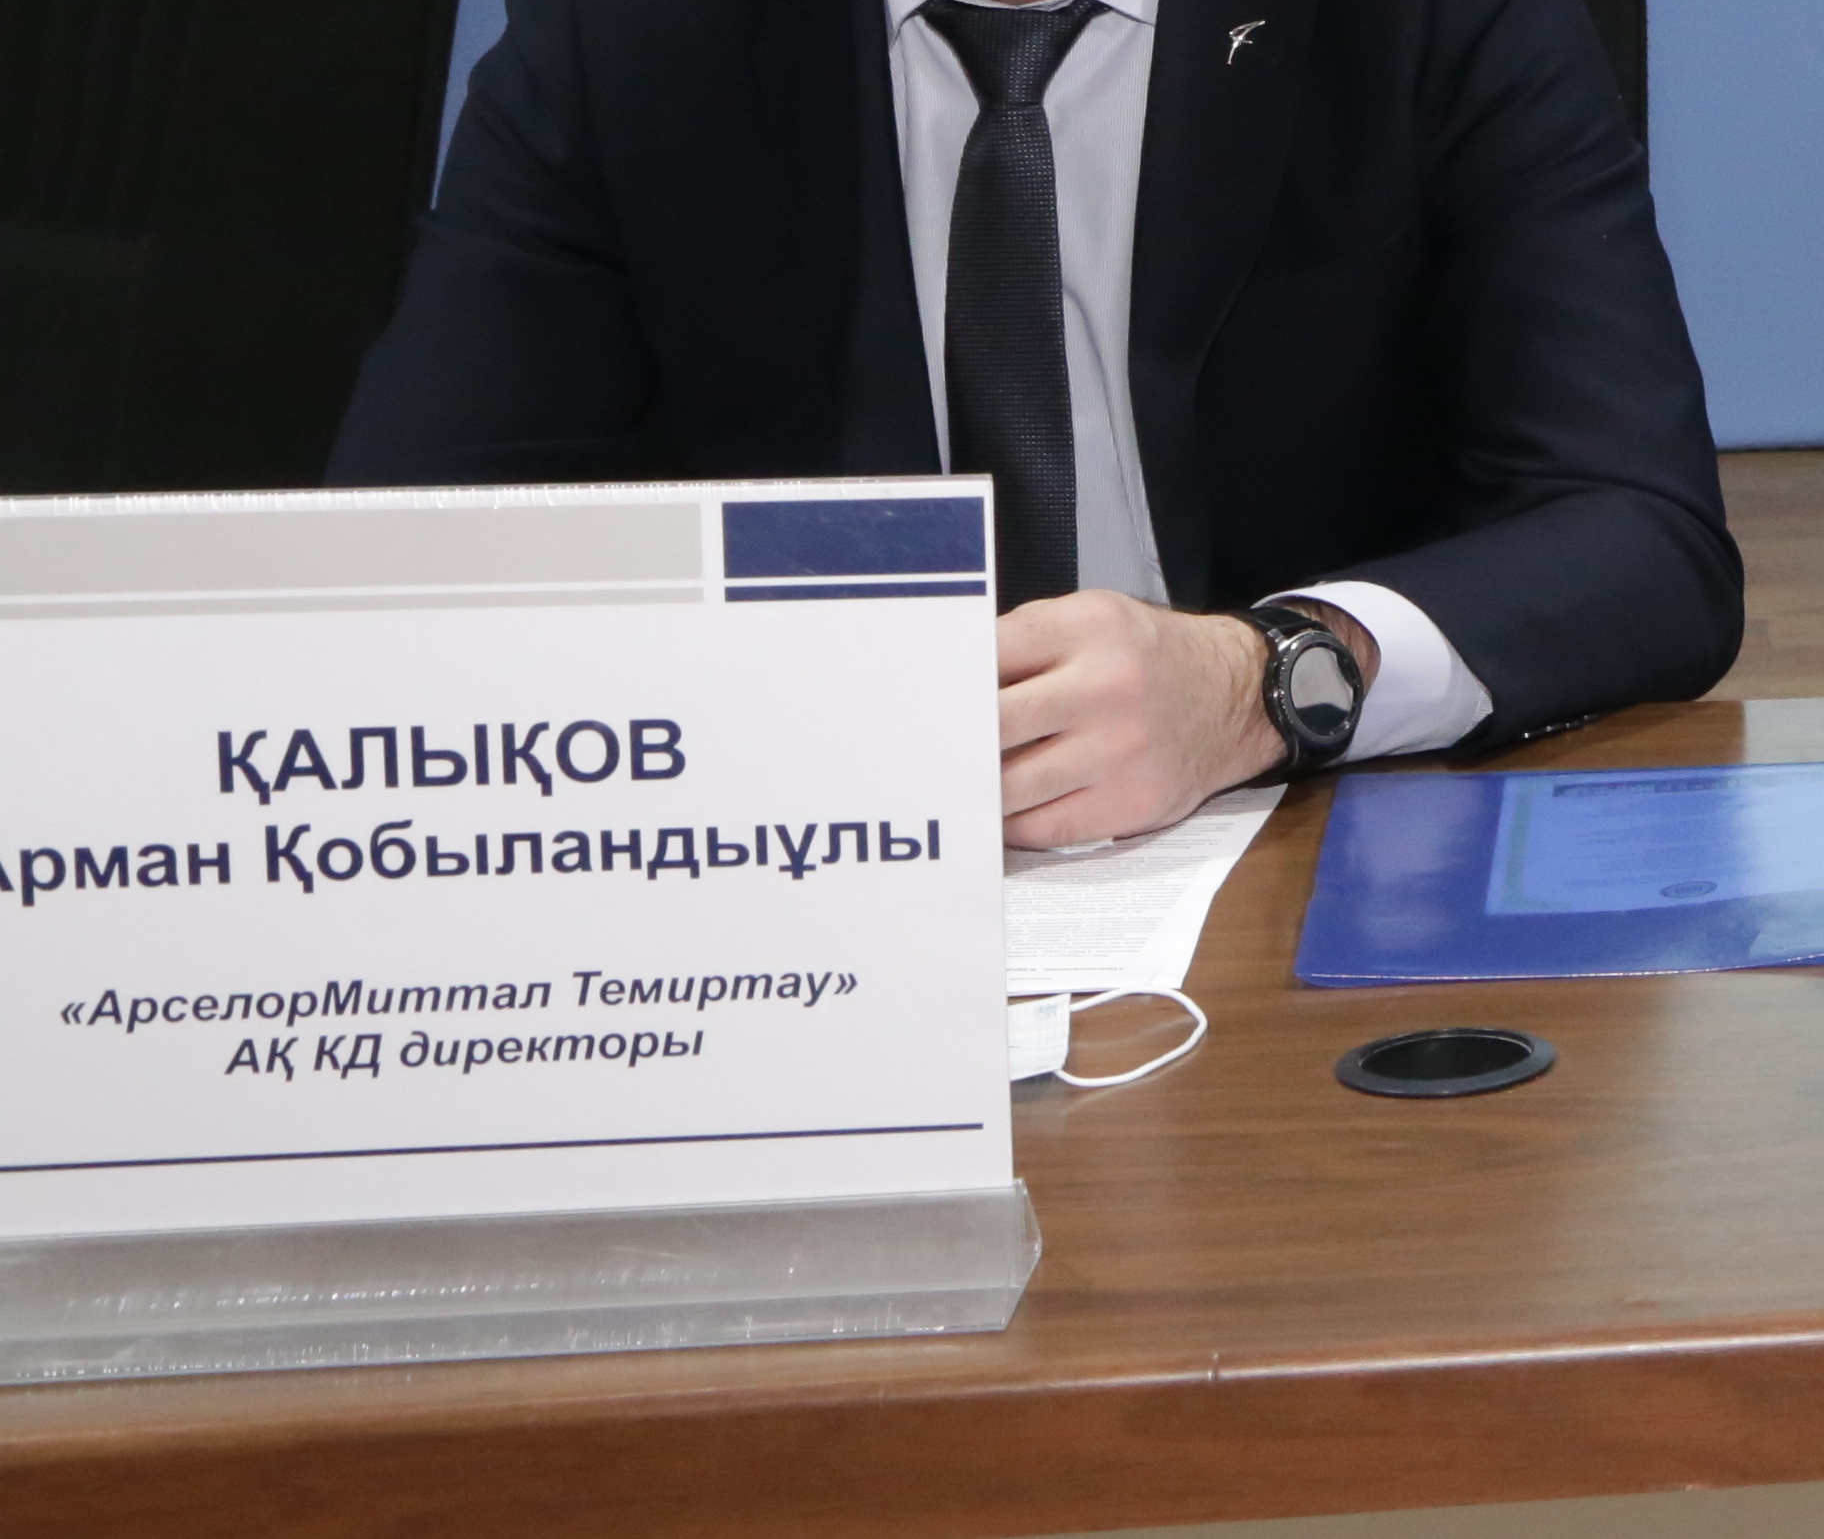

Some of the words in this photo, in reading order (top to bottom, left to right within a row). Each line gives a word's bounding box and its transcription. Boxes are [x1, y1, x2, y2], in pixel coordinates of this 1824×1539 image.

[218, 719, 686, 806] ҚАЛЫҚОВ
[0, 843, 231, 907] рман
[265, 819, 940, 894] Қобыландыұлы
[60, 980, 551, 1034] «АрселорМиттал
[573, 971, 857, 1011] Темиртау»
[225, 1037, 298, 1082] АҚ
[314, 1033, 382, 1079] КД
[399, 1030, 704, 1074] директоры
